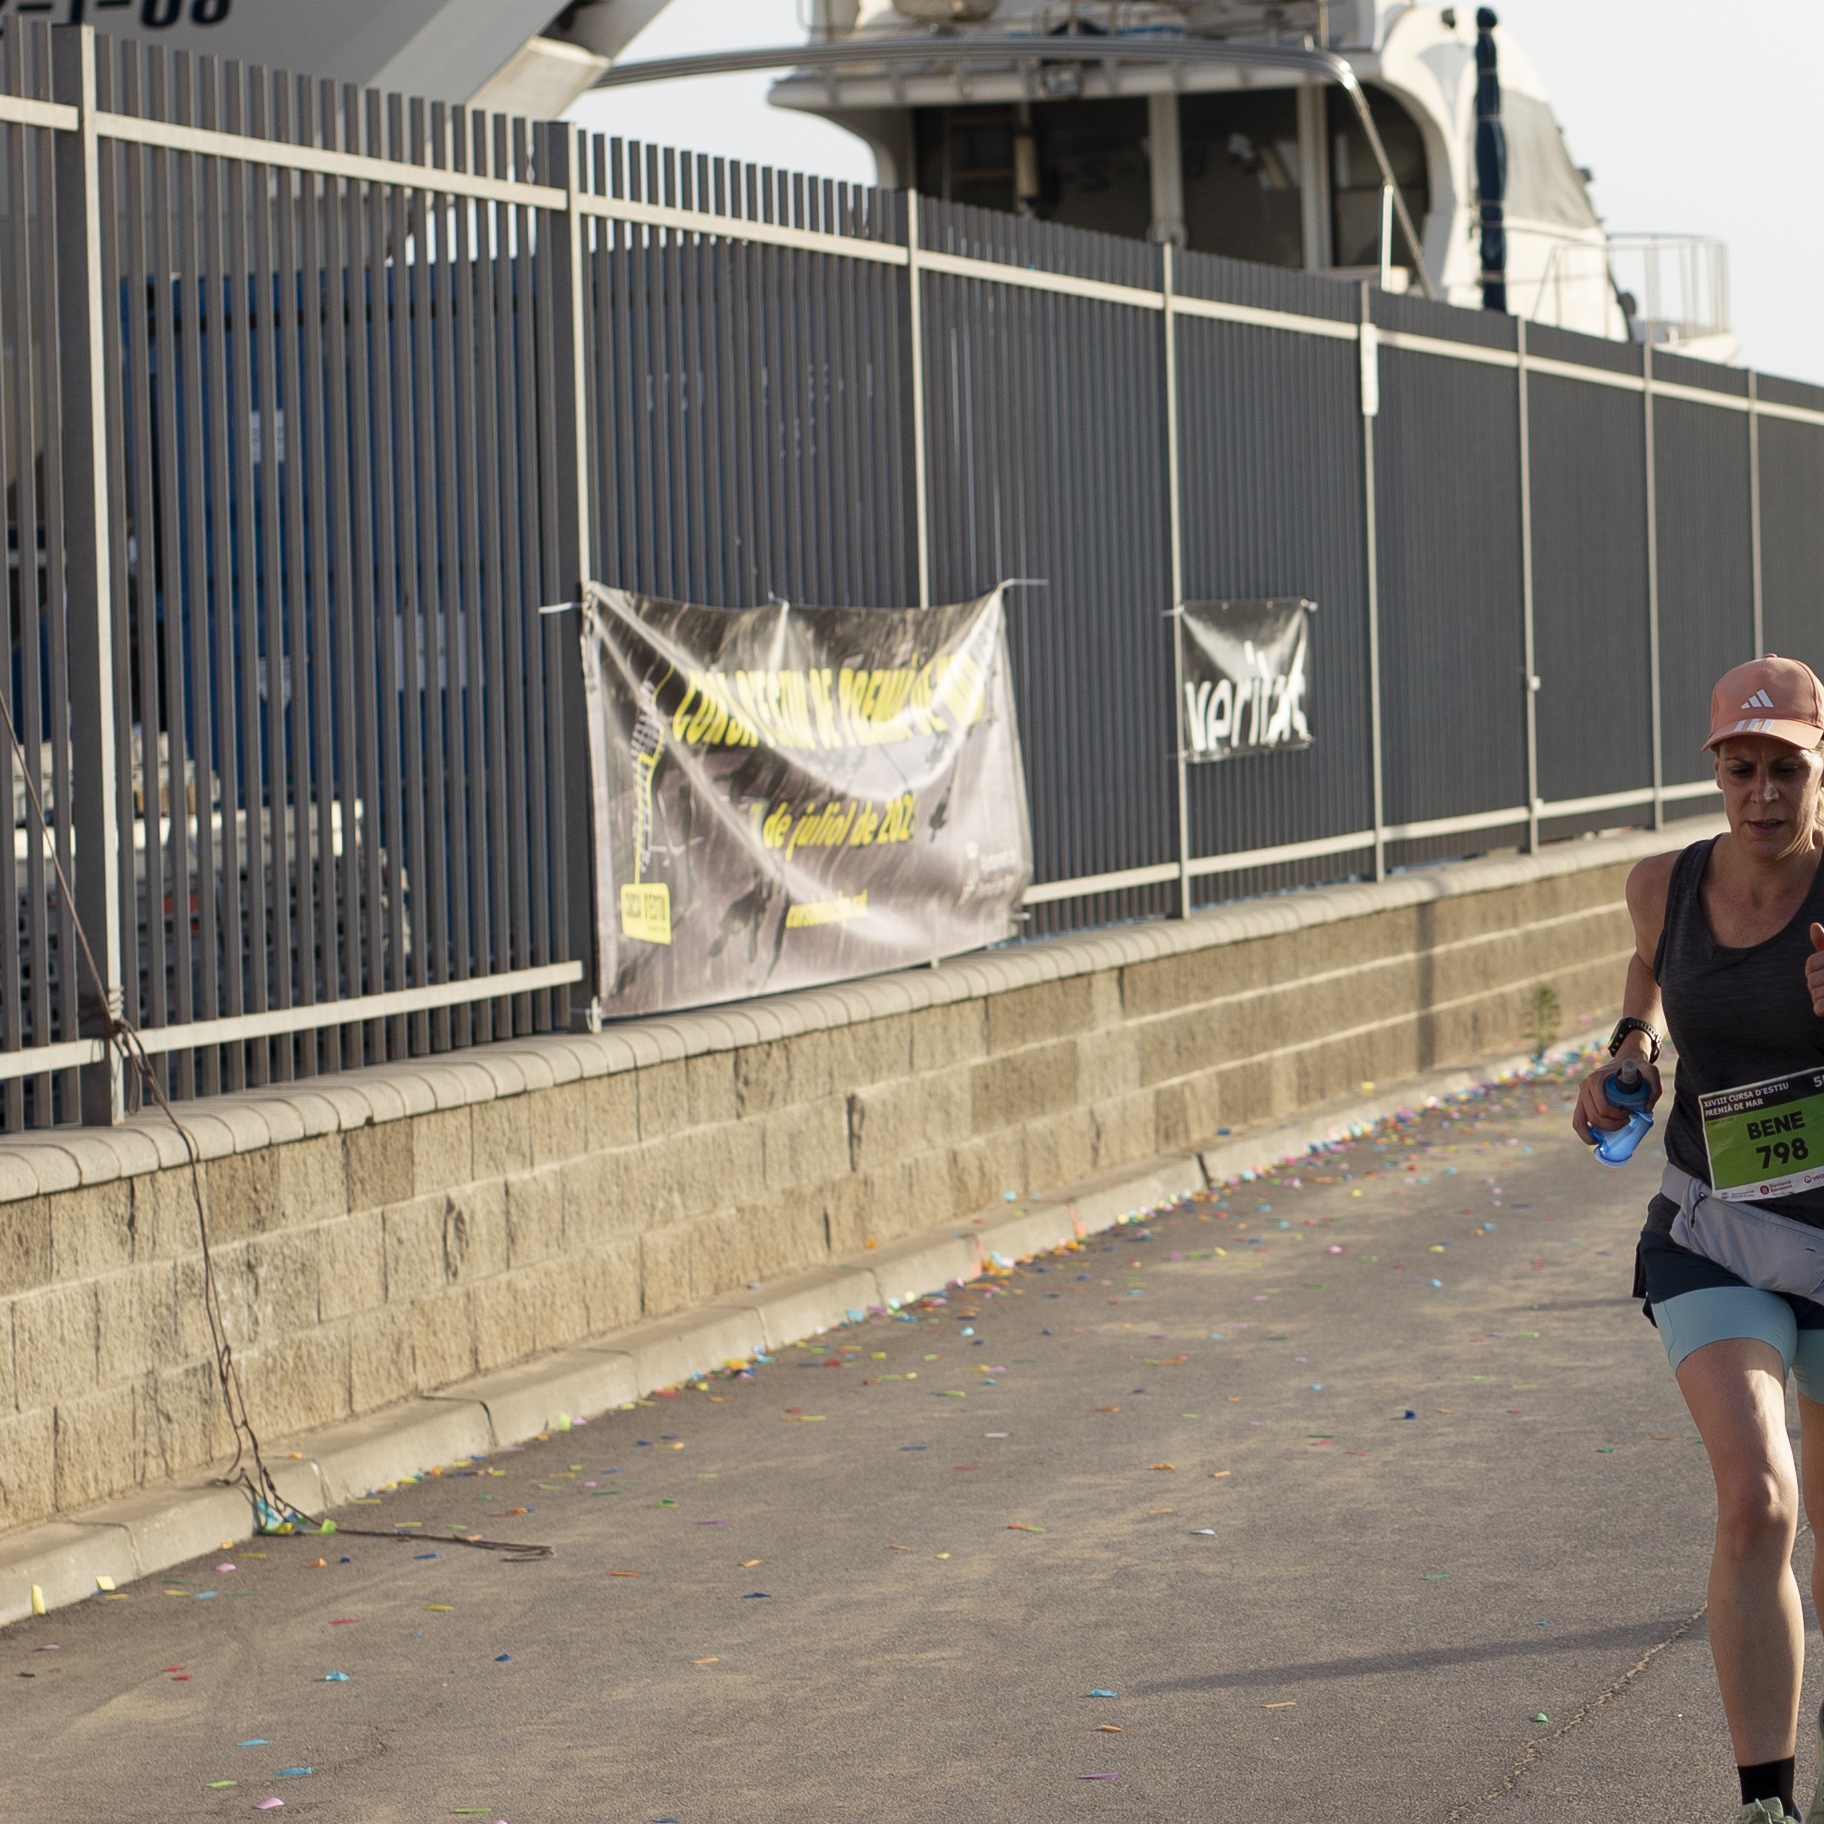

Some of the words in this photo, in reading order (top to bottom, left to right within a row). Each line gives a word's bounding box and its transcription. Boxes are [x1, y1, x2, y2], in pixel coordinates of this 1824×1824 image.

[1728, 1090, 1754, 1103] CURSA
[1754, 1082, 1789, 1097] D'ESTIU
[1733, 1101, 1744, 1111] DE
[1745, 1098, 1764, 1109] MAR
[1746, 1110, 1806, 1140] BENE
[1755, 1137, 1809, 1169] 798
